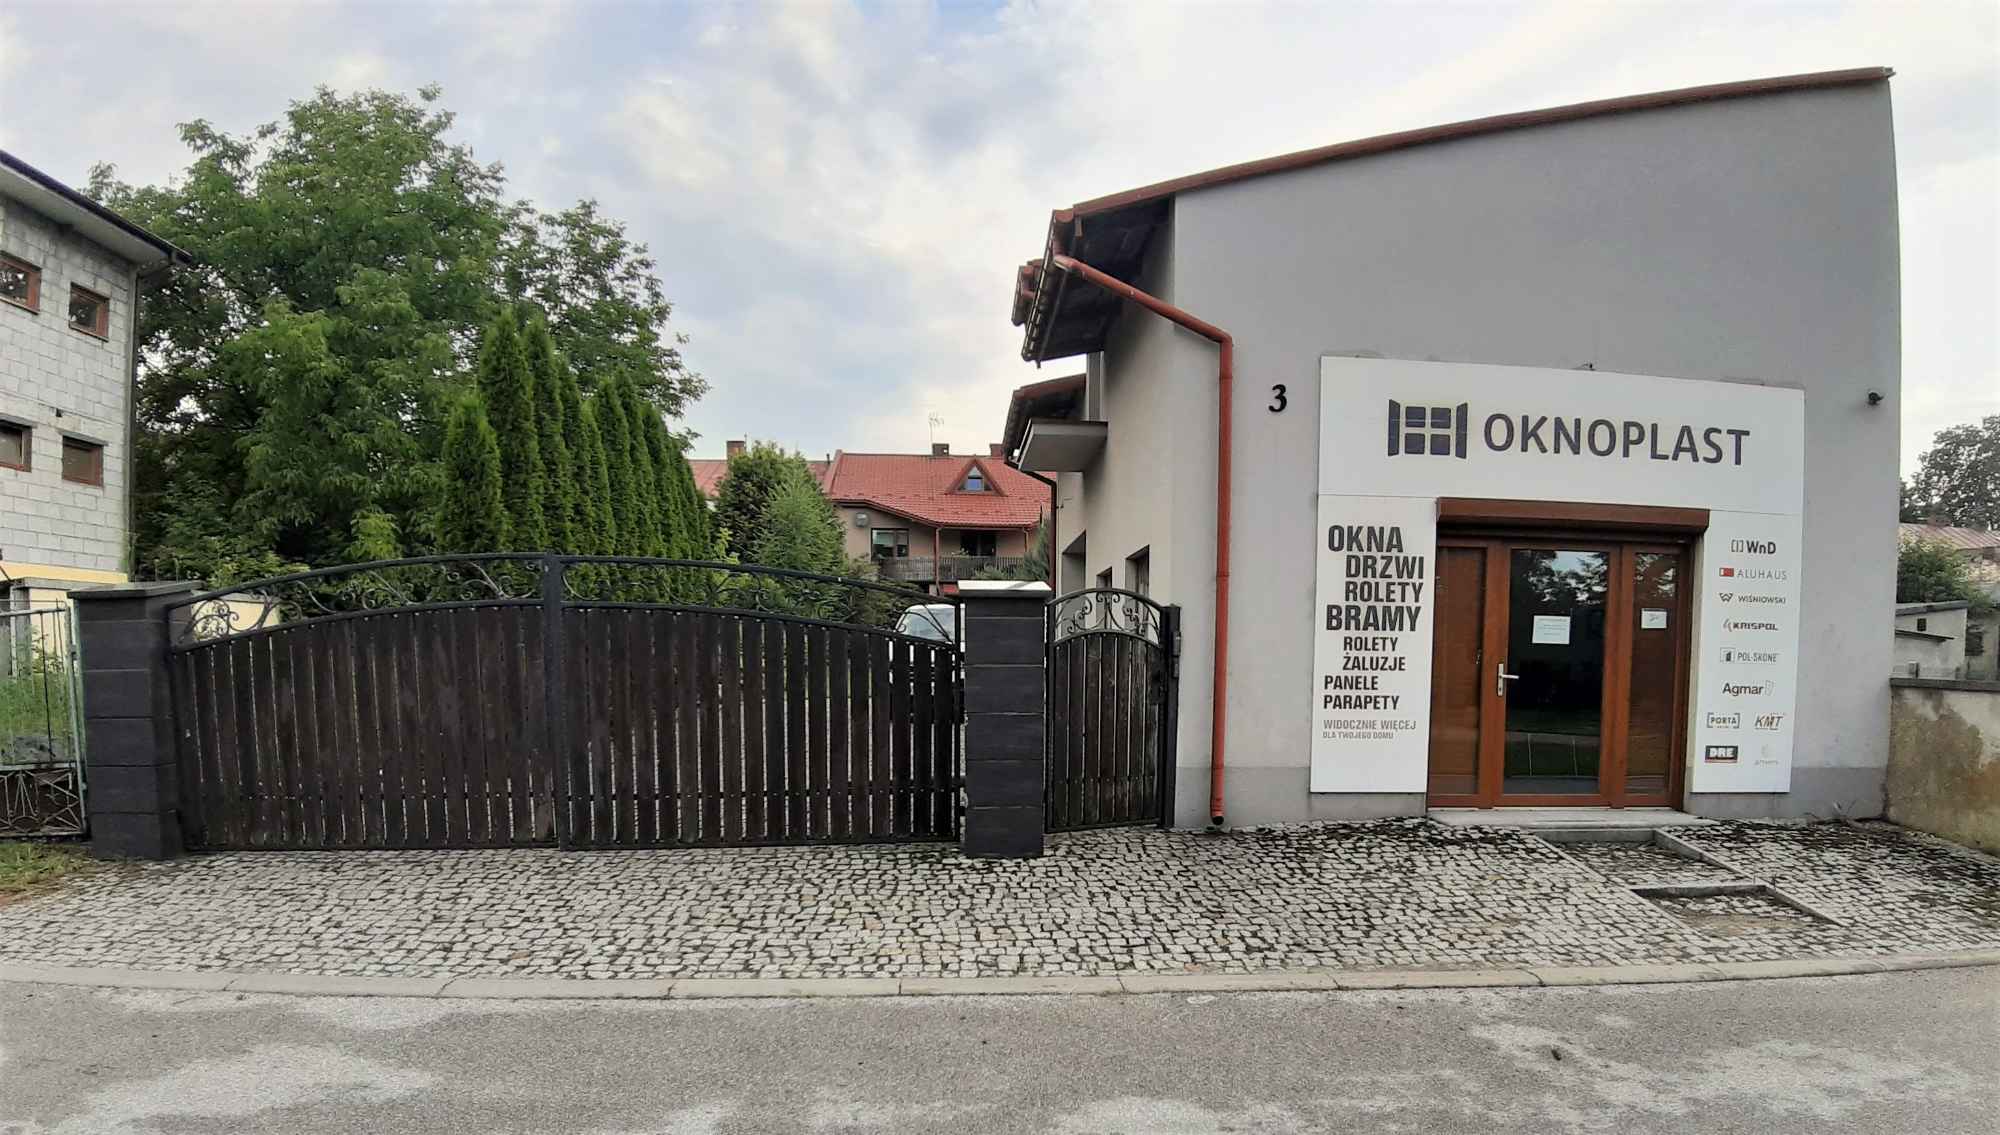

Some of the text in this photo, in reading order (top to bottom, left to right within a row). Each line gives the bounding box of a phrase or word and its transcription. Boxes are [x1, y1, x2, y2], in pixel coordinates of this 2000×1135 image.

[1268, 384, 1287, 413] 3
[1483, 413, 1750, 466] OKNOPLAST
[1328, 525, 1403, 552] OKNA
[1747, 540, 1776, 554] WnD
[1345, 555, 1424, 579] DRZWI
[1737, 568, 1787, 580] ALUHAUS
[1345, 581, 1423, 603] ROLETY
[1326, 604, 1421, 631] BRAMY
[1343, 636, 1398, 651] ROLETY
[1342, 652, 1406, 671] ŻALUZJE
[1324, 675, 1379, 690] PANELE
[1722, 682, 1764, 696] Agmar
[1323, 695, 1400, 710] PARAPETY
[1323, 719, 1417, 732] WIDOCZNIE WIĘCEJ
[1709, 748, 1735, 757] DRE
